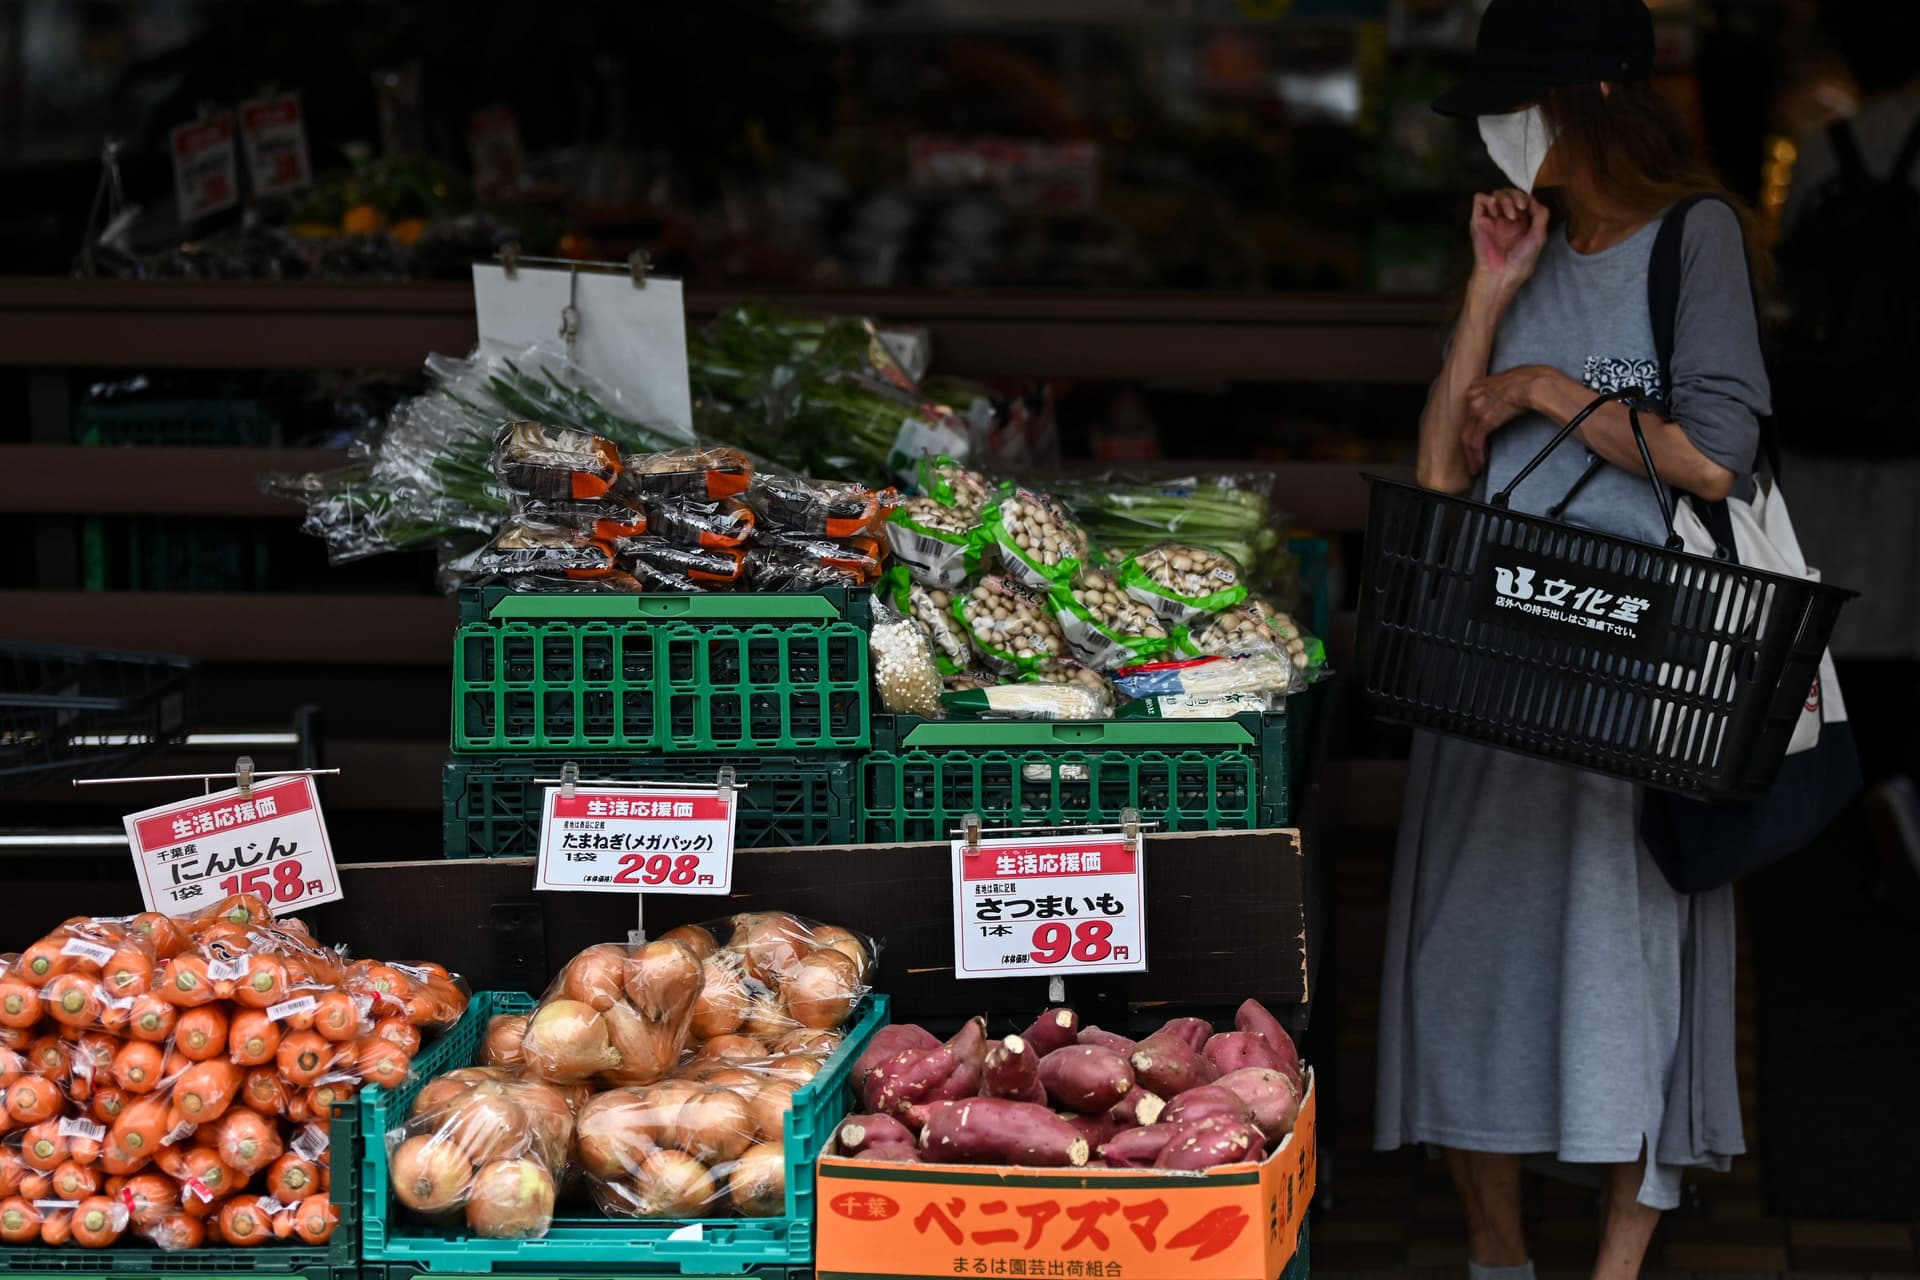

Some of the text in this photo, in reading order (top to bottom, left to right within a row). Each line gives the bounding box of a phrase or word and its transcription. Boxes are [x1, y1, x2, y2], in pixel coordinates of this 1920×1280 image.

[1535, 578, 1650, 624] 文化堂
[172, 796, 278, 840] 生活応援価
[586, 800, 694, 818] 生活応援価
[157, 843, 198, 861] 千葉産
[171, 837, 298, 885] にんじん
[996, 852, 1102, 875] 生活応援価
[975, 893, 1124, 921] さつまいも
[980, 925, 1013, 938] 1本
[839, 1196, 889, 1219] 千葉
[913, 1196, 1169, 1253] ベニアズマ
[952, 1256, 1123, 1278] まるは園芸出荷組合
